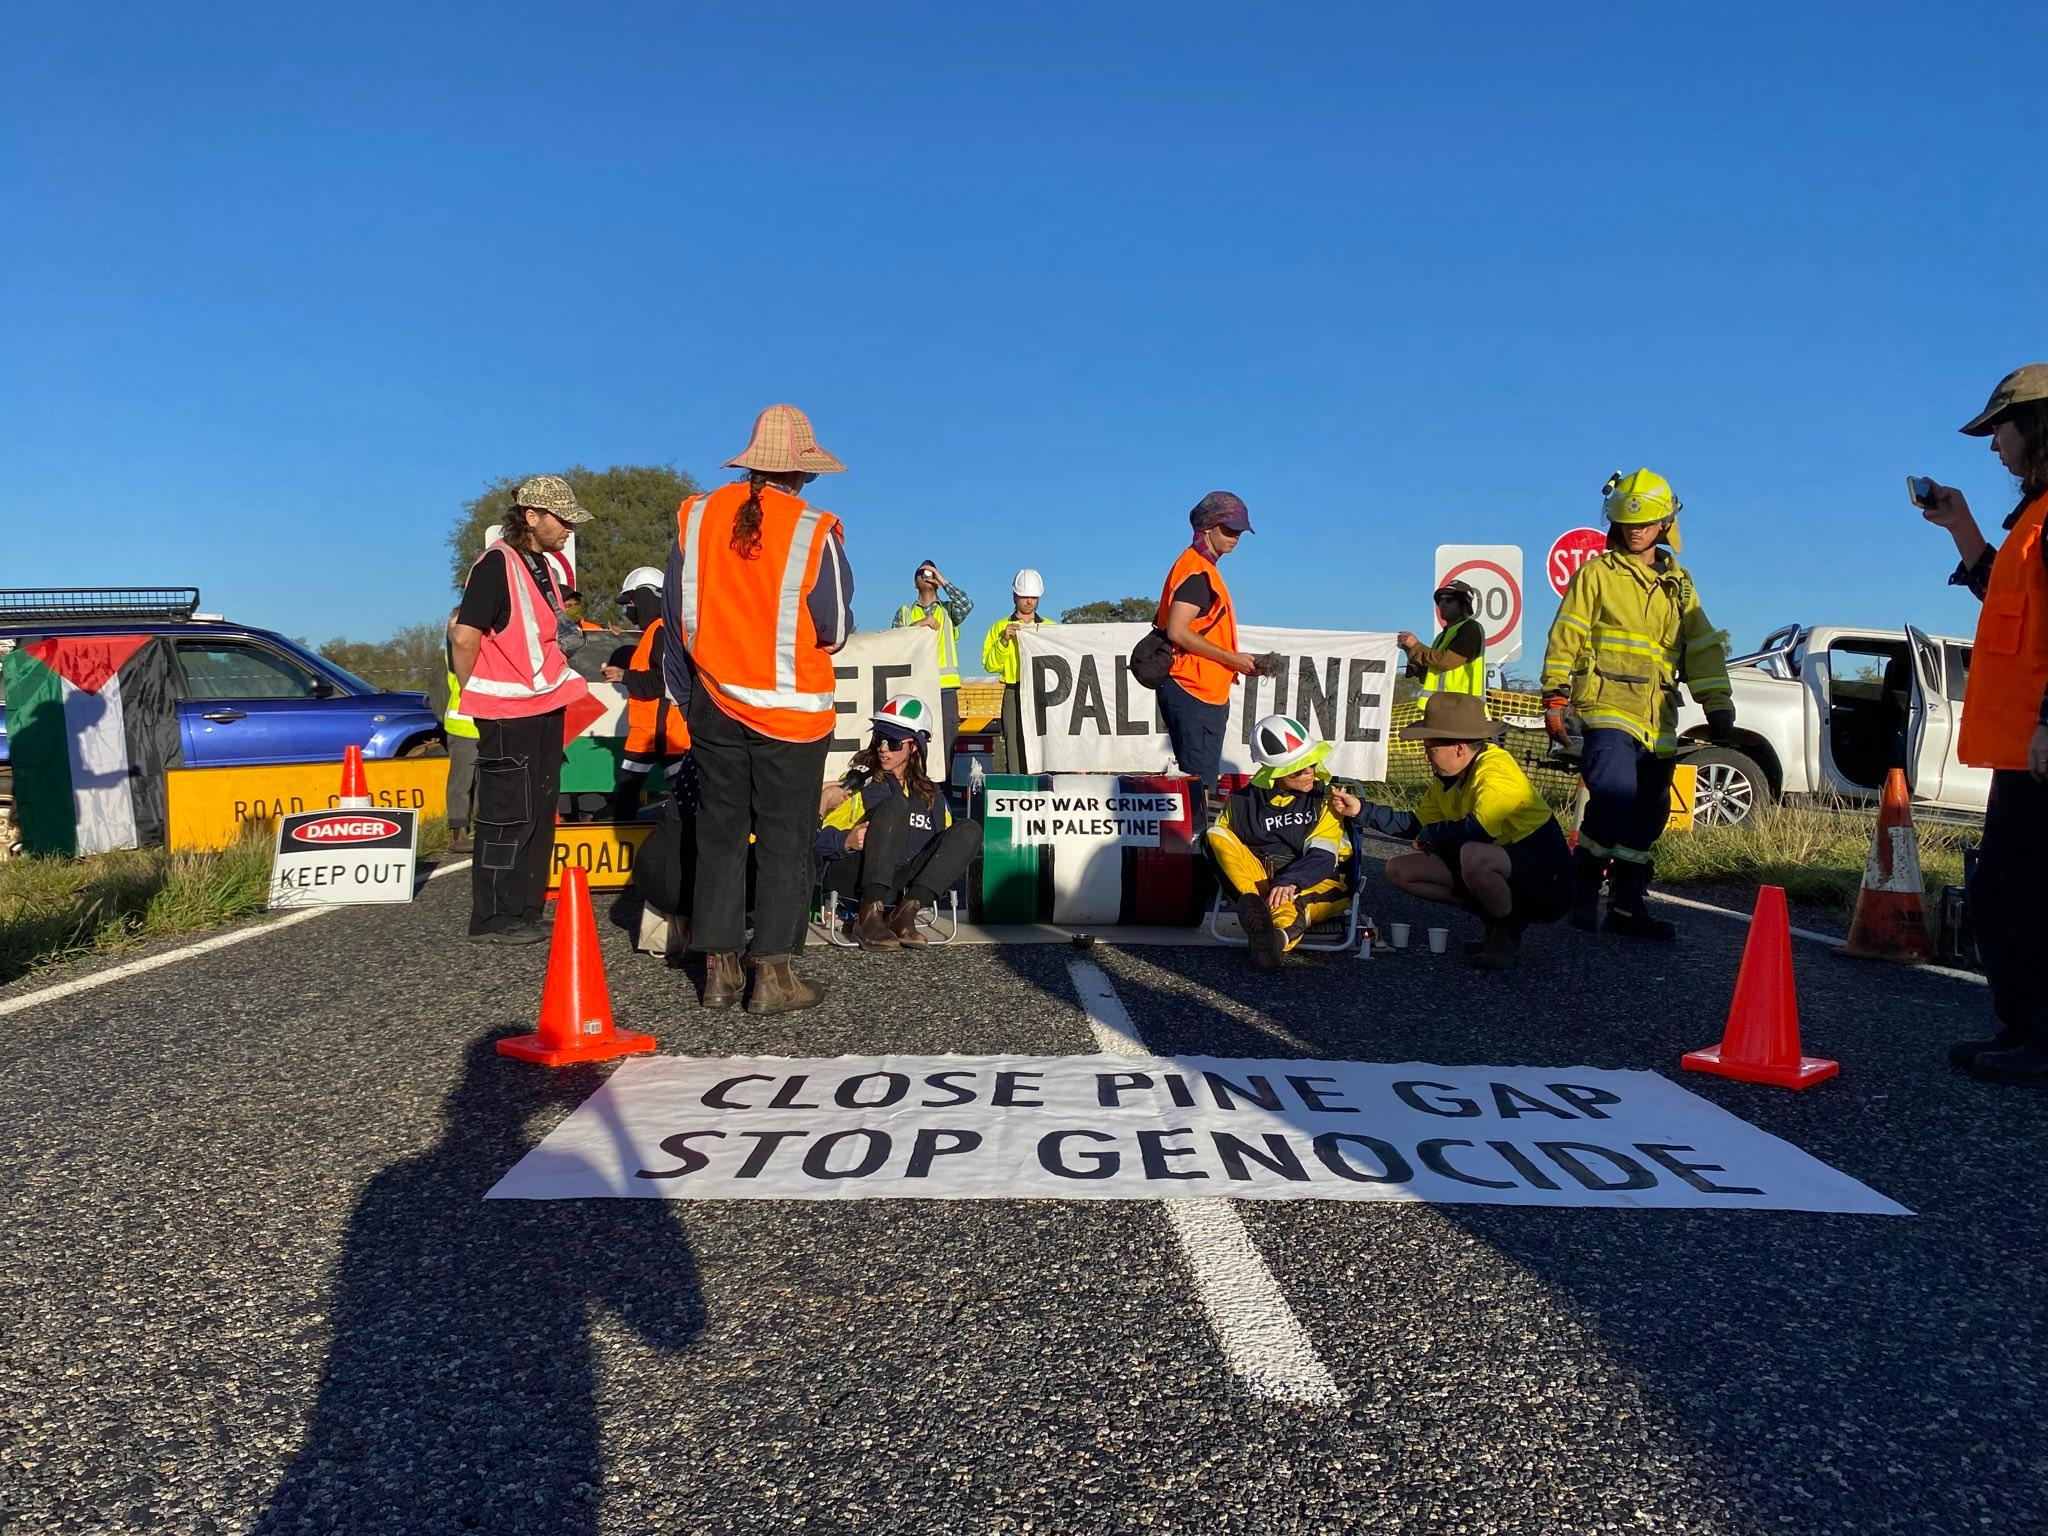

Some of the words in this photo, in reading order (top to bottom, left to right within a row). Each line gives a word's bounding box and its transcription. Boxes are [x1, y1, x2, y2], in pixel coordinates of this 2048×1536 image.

[1554, 549, 1613, 587] ST
[234, 796, 304, 823] ROAD
[995, 798, 1046, 812] STOP
[1052, 797, 1100, 812] WAR
[1105, 798, 1178, 812] CRIMES
[306, 822, 386, 839] DANGER
[1026, 819, 1046, 836] IN
[1052, 819, 1159, 836] PALESTINE
[552, 840, 636, 875] ROAD
[280, 865, 346, 889] KEEP
[354, 863, 407, 885] OUT
[701, 1071, 1045, 1110] CLOSE
[1095, 1071, 1362, 1113] PINE
[1391, 1080, 1622, 1120] GAP
[633, 1128, 983, 1180] STOP
[1036, 1128, 1767, 1195] GENOCIDE
